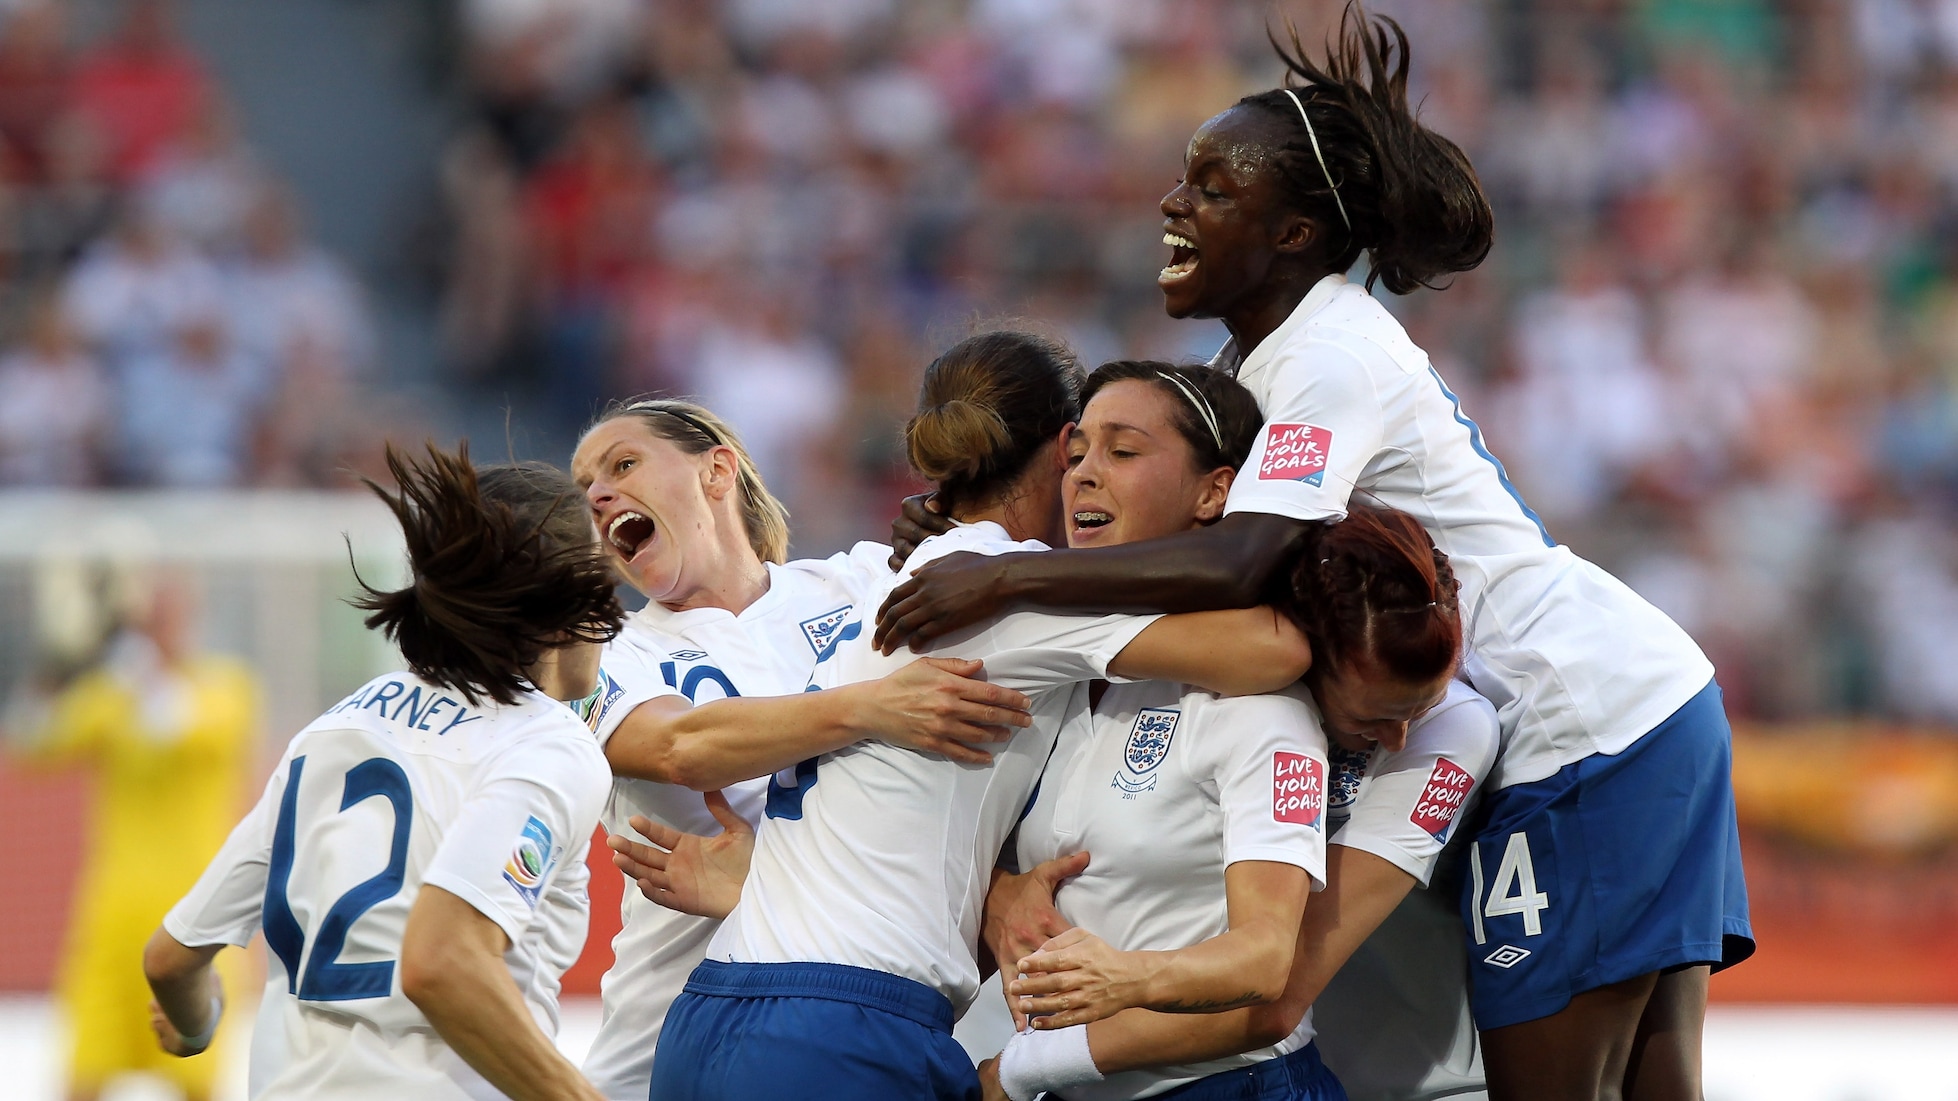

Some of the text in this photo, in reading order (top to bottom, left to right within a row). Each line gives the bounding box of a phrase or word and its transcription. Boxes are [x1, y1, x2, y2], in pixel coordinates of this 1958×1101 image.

[1269, 426, 1312, 446] LIVE
[1266, 441, 1322, 460] YOUR
[1262, 455, 1325, 475] GOALS
[1276, 758, 1312, 777] LIVE
[1275, 776, 1320, 797] YOUR
[1433, 768, 1468, 788] LIVE
[1427, 784, 1463, 805] YOUR
[1275, 794, 1321, 816] GOALS
[1417, 801, 1457, 821] GOALS
[262, 755, 413, 1001] 12
[1470, 831, 1549, 945] 14
